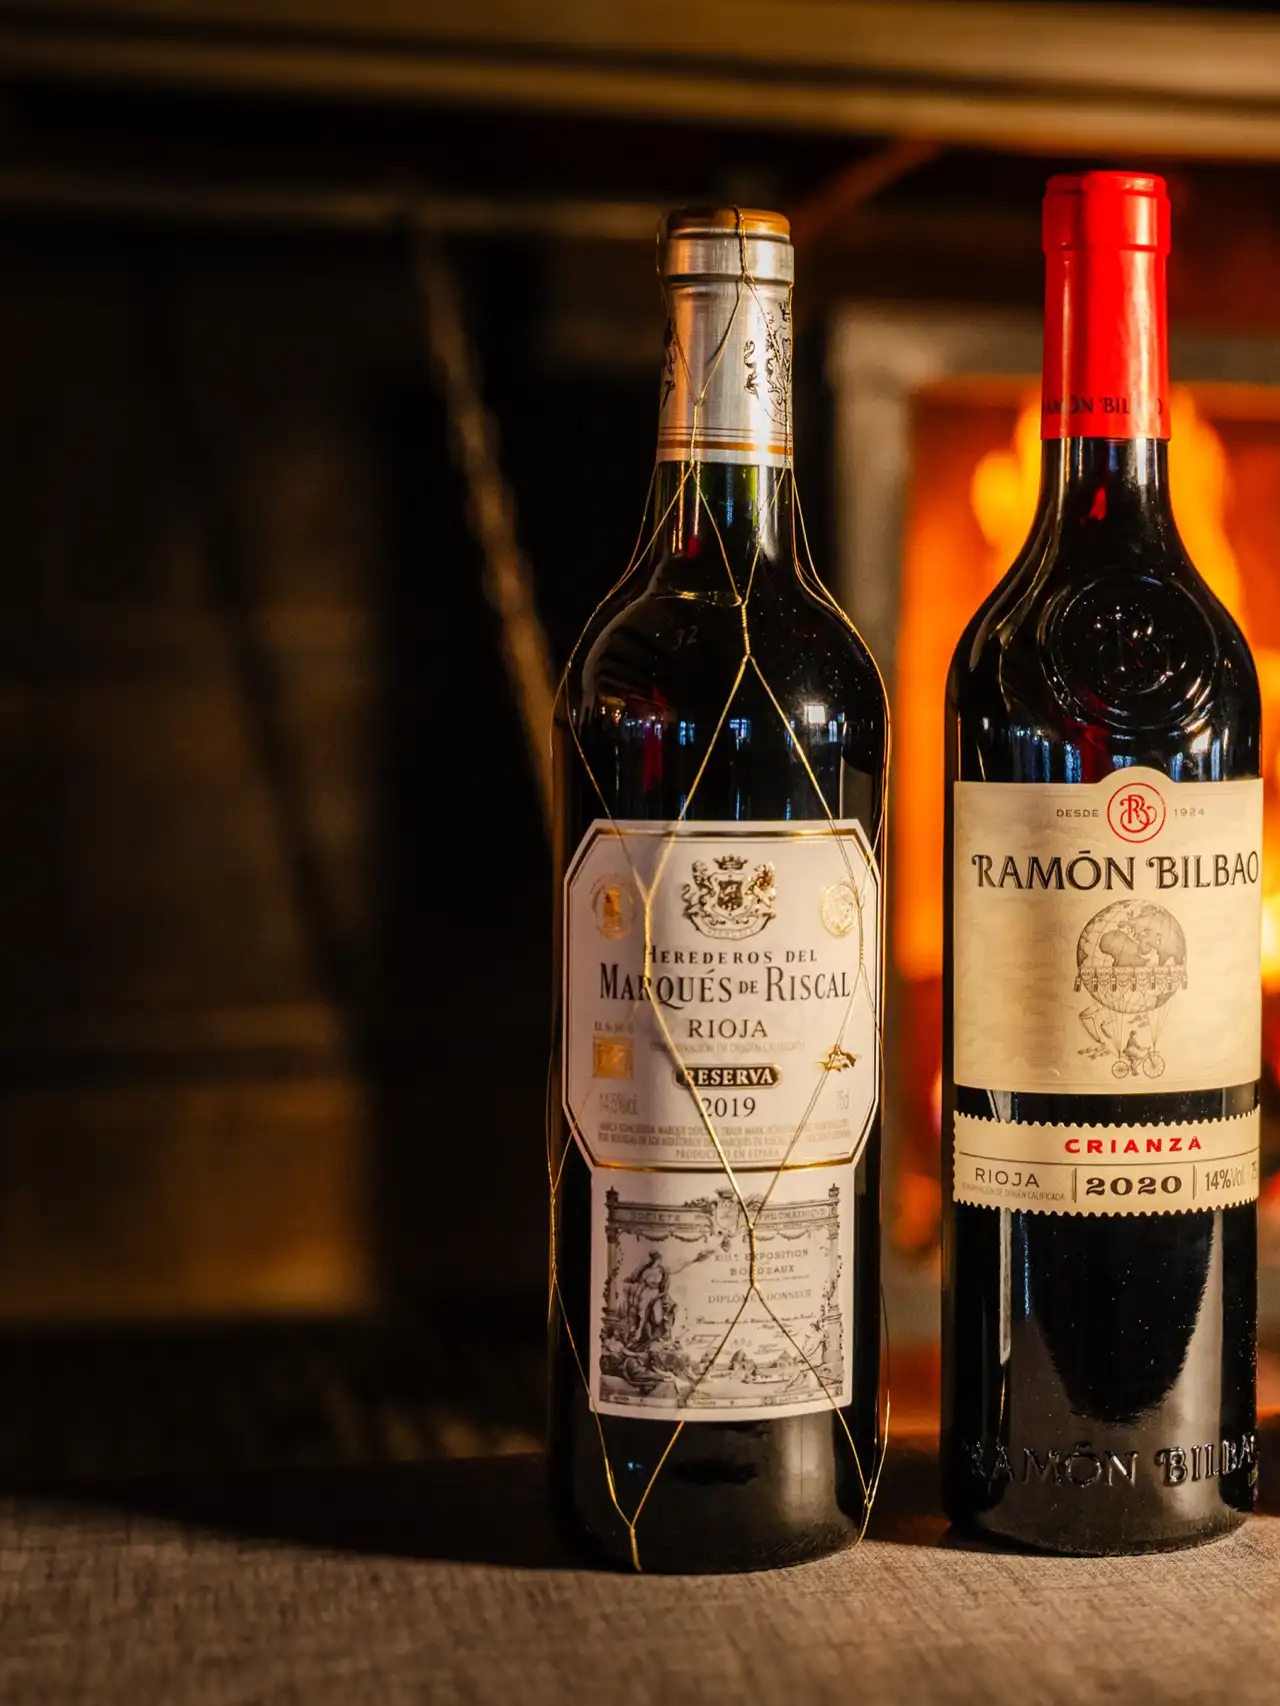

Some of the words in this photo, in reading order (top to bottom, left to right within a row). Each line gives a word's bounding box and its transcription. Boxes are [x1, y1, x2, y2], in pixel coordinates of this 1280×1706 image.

[1056, 808, 1100, 818] DESDE
[1173, 808, 1205, 817] 1924
[971, 849, 1136, 891] RAMÓN
[1145, 850, 1260, 890] BILBAO
[645, 946, 773, 965] HEREDEROS
[786, 948, 818, 963] DEL
[600, 962, 732, 1010] MARQUÉS
[739, 980, 759, 995] DE
[766, 966, 851, 1002] RISCAL
[688, 1018, 768, 1039] RIOJA
[685, 1065, 775, 1085] RESERVA
[700, 1096, 756, 1119] 2019
[1065, 1136, 1203, 1155] CRIANZA
[975, 1167, 1040, 1188] RIOJA
[1085, 1174, 1183, 1196] 2020
